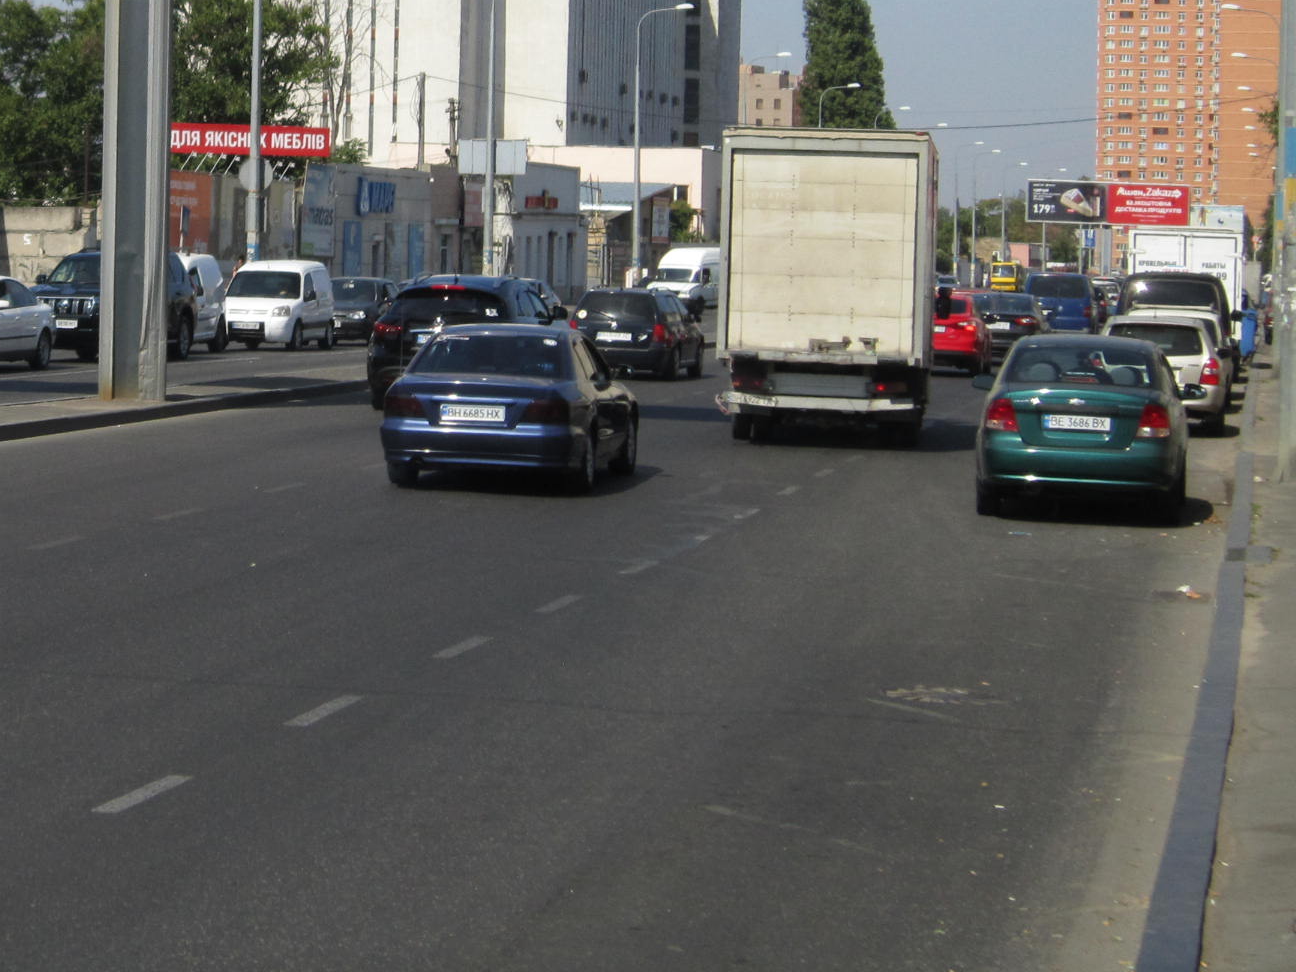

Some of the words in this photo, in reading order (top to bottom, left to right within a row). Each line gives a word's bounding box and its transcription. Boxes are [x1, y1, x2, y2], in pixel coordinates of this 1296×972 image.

[170, 129, 201, 148] ДЛЯ
[205, 130, 267, 149] ЯКІСНХ
[271, 133, 325, 150] МЕБЛІВ
[447, 408, 462, 417] BH
[464, 408, 485, 418] 6685
[487, 409, 500, 418] HX
[1050, 416, 1064, 426] BE
[1067, 417, 1090, 427] 3686
[1092, 418, 1106, 428] BX
